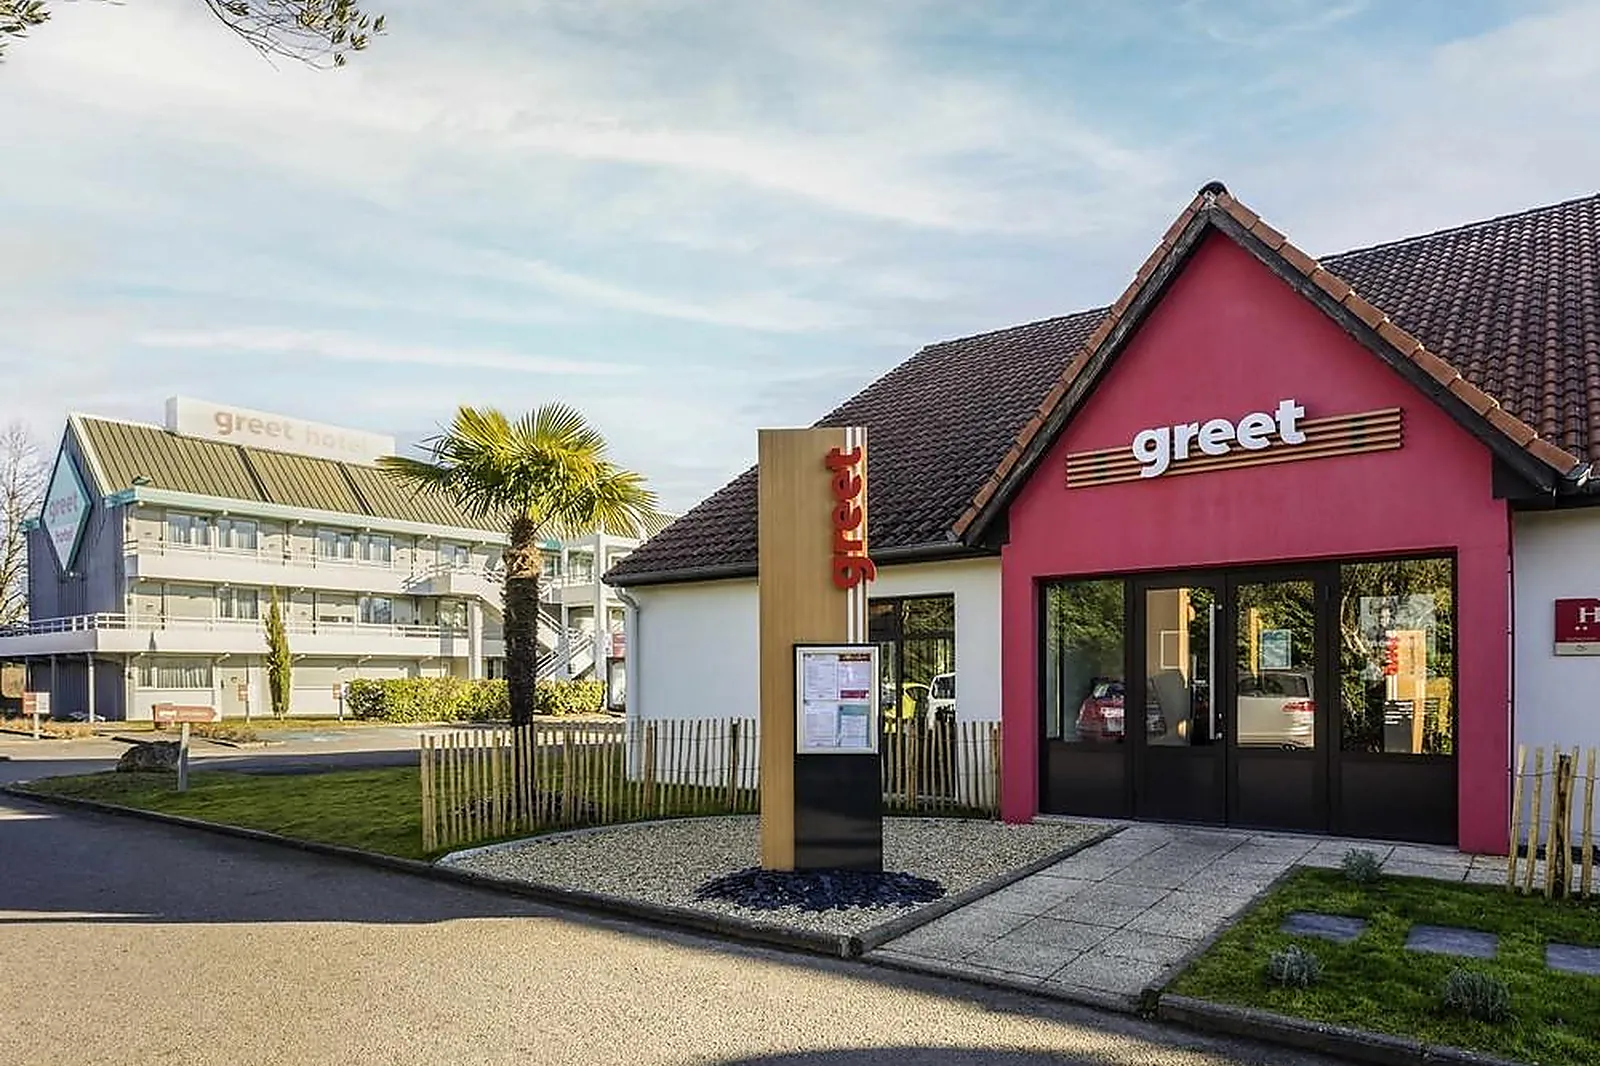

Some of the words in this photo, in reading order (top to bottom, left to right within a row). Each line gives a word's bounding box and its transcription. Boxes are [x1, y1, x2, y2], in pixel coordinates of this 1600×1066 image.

[214, 411, 294, 440] greet
[306, 424, 368, 455] hotel
[1132, 399, 1306, 478] greet
[826, 446, 877, 589] greet
